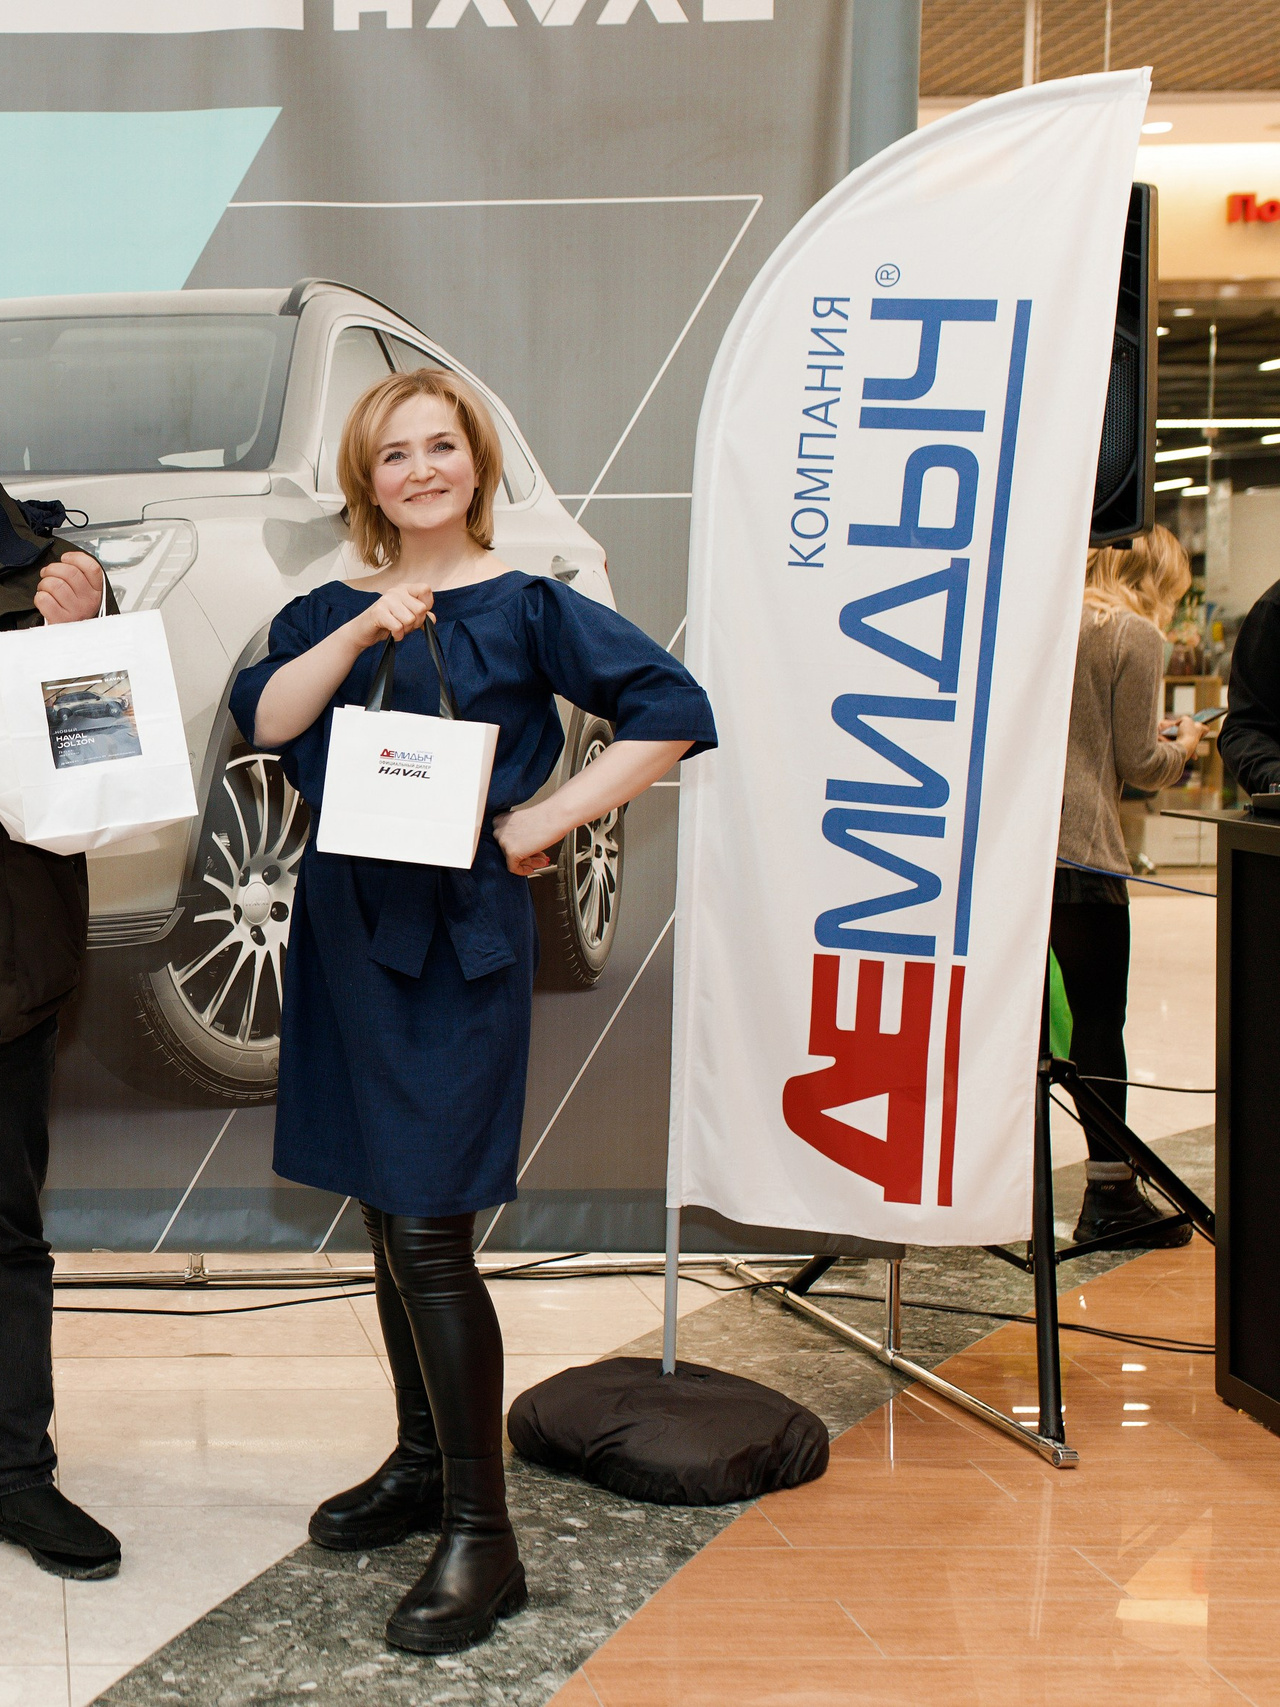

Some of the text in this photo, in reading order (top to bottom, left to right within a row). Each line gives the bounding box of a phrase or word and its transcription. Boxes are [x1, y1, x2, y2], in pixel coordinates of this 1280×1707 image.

[787, 296, 851, 568] КОМПАНИЯ
[56, 732, 88, 742] HAVAL
[57, 738, 95, 749] JOLION
[782, 298, 998, 1206] ДЕМИДЫЧ
[378, 766, 431, 779] HAVAL
